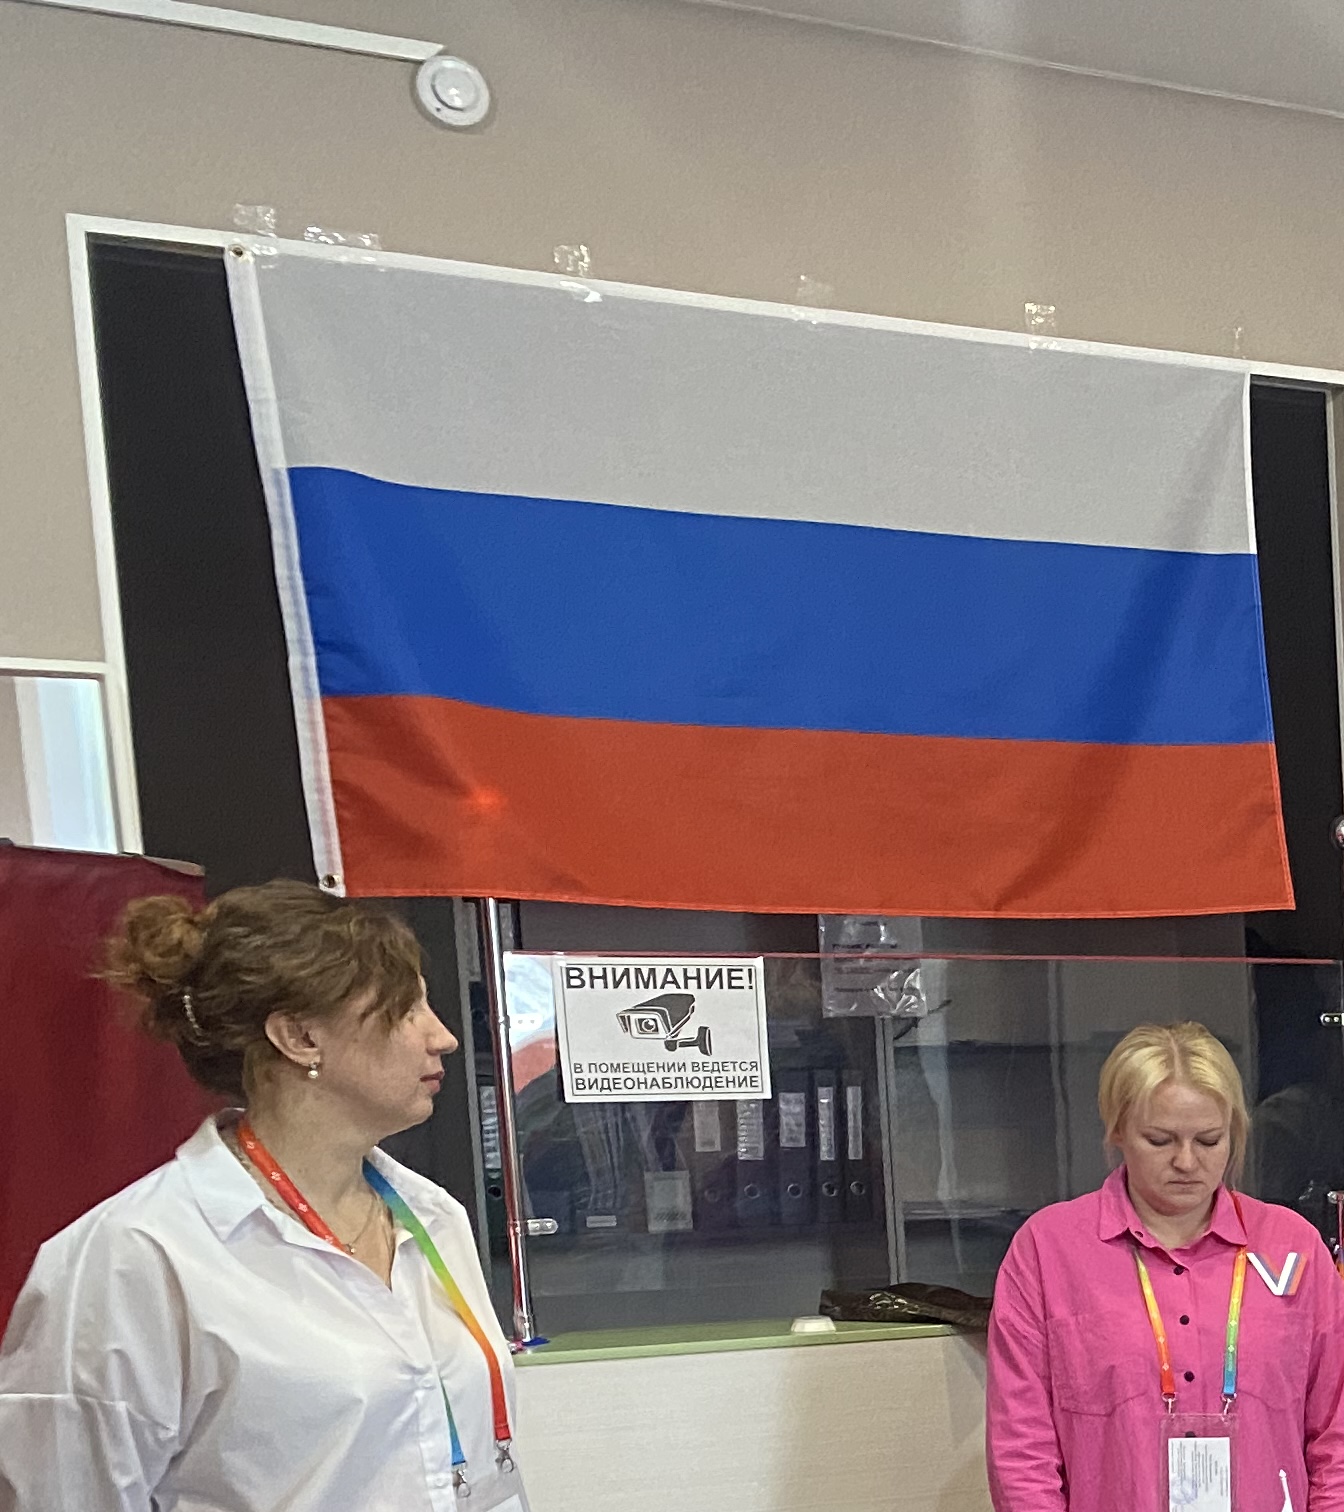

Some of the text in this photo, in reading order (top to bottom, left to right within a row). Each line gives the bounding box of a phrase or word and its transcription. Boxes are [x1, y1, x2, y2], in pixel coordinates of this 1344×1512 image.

[565, 966, 754, 990] ВНИМАНИЕ!
[573, 1060, 759, 1075] В ПОМЕЩЕНИИ ВЕДЕТСЯ
[575, 1075, 760, 1093] ВИДЕОНАБЛЮДЕНИЕ
